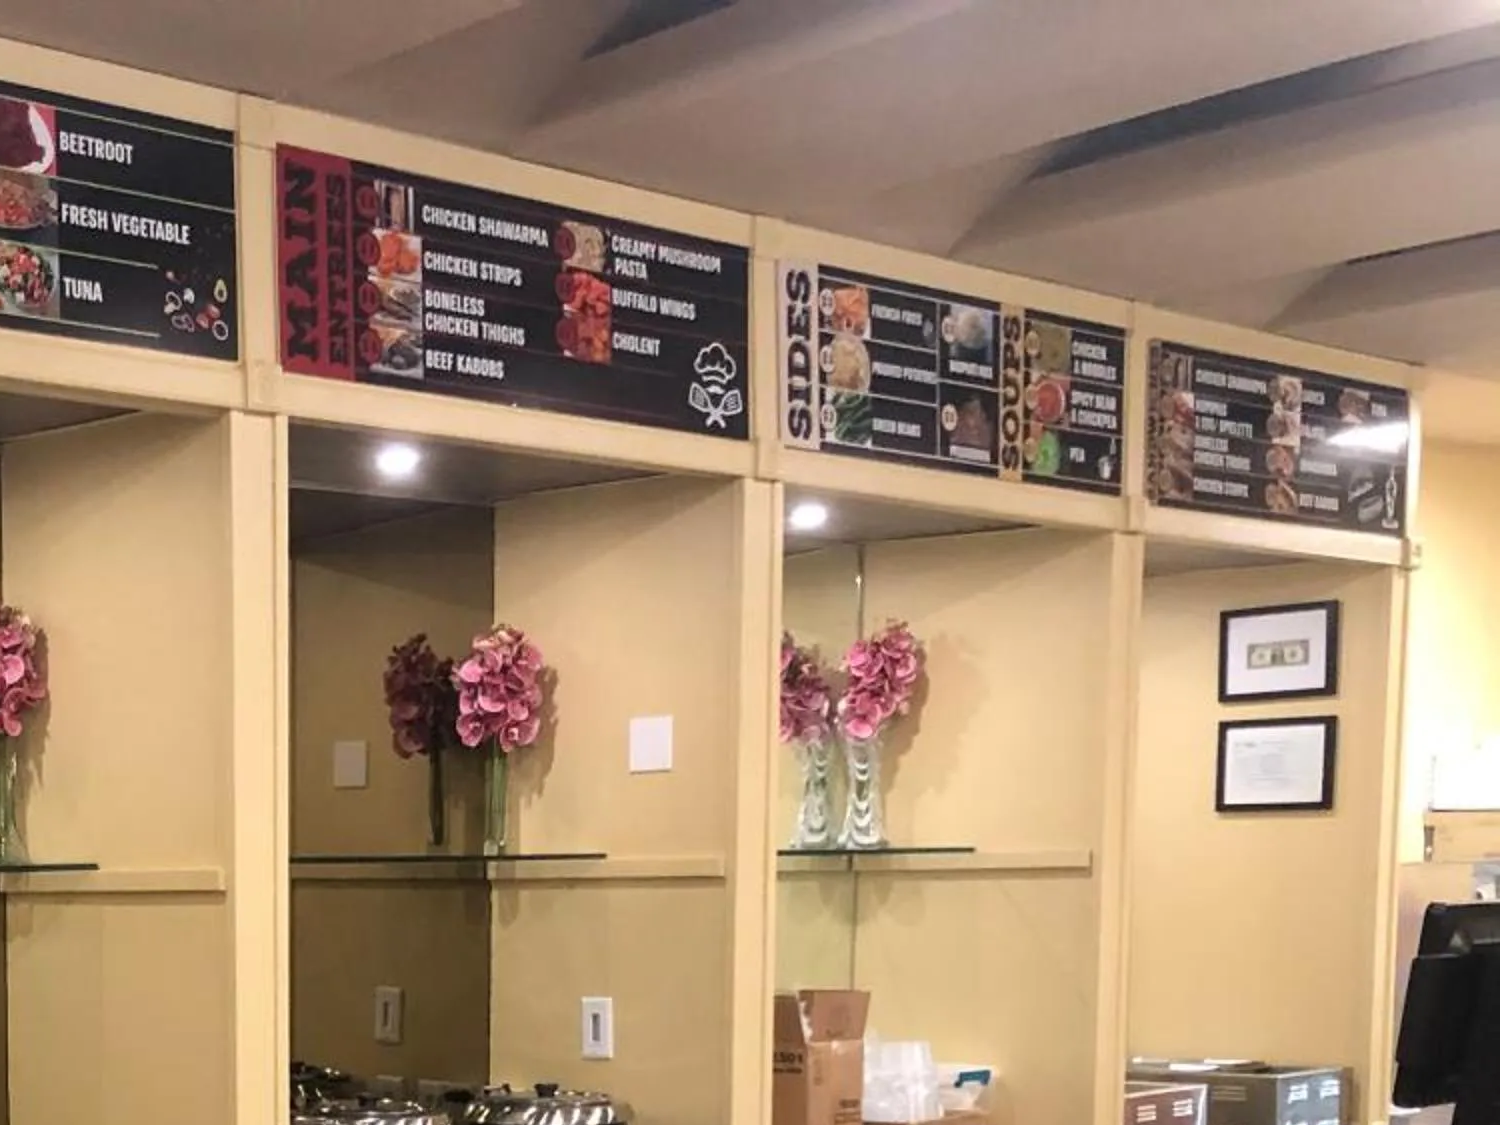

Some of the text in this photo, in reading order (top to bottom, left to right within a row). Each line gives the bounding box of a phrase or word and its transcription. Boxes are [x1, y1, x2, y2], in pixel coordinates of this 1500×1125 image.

[59, 131, 134, 165] BEETROOT
[61, 203, 192, 245] FRESH VEGETABLE
[422, 205, 477, 232] CHICKEN
[284, 159, 319, 362] MAIN
[424, 251, 522, 286] CHICKEN STRIPS
[63, 277, 103, 302] TUNA
[425, 290, 484, 317] BONELESS
[425, 314, 525, 346] CHICKEN THIGHS
[425, 350, 454, 369] BEEF
[786, 269, 812, 440] SIDES
[1002, 316, 1021, 470] SOUPS
